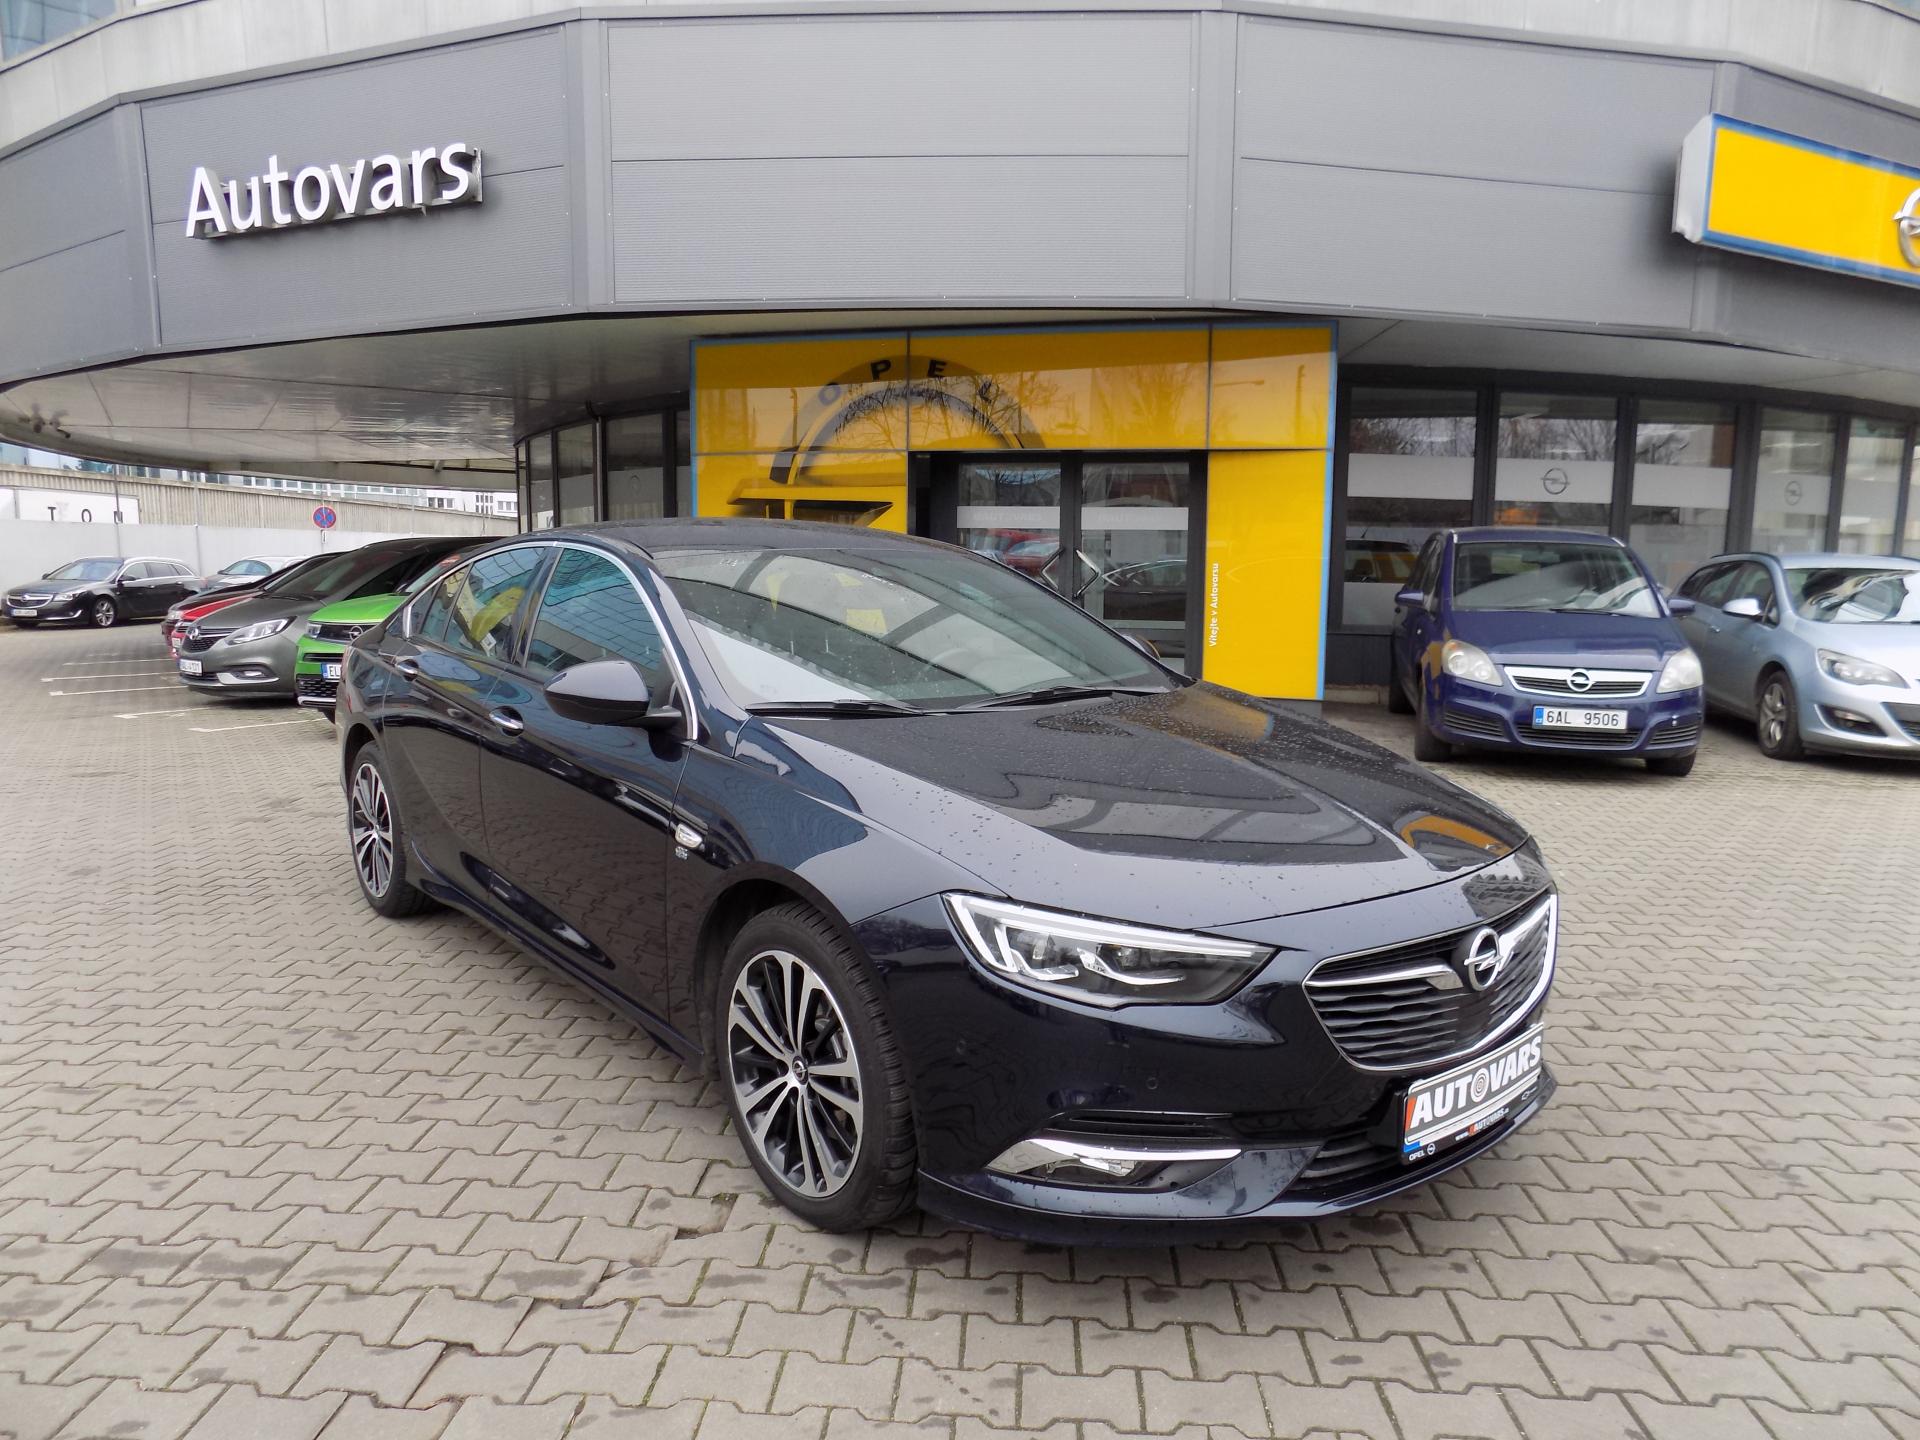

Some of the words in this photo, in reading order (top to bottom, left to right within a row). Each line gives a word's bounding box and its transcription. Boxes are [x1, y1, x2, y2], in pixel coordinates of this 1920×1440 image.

[185, 143, 471, 237] Autovars
[1546, 711, 1571, 724] 6AL
[1584, 712, 1619, 727] 9506
[1410, 1035, 1542, 1128] AUTOVARS
[1408, 1150, 1425, 1161] OPEL
